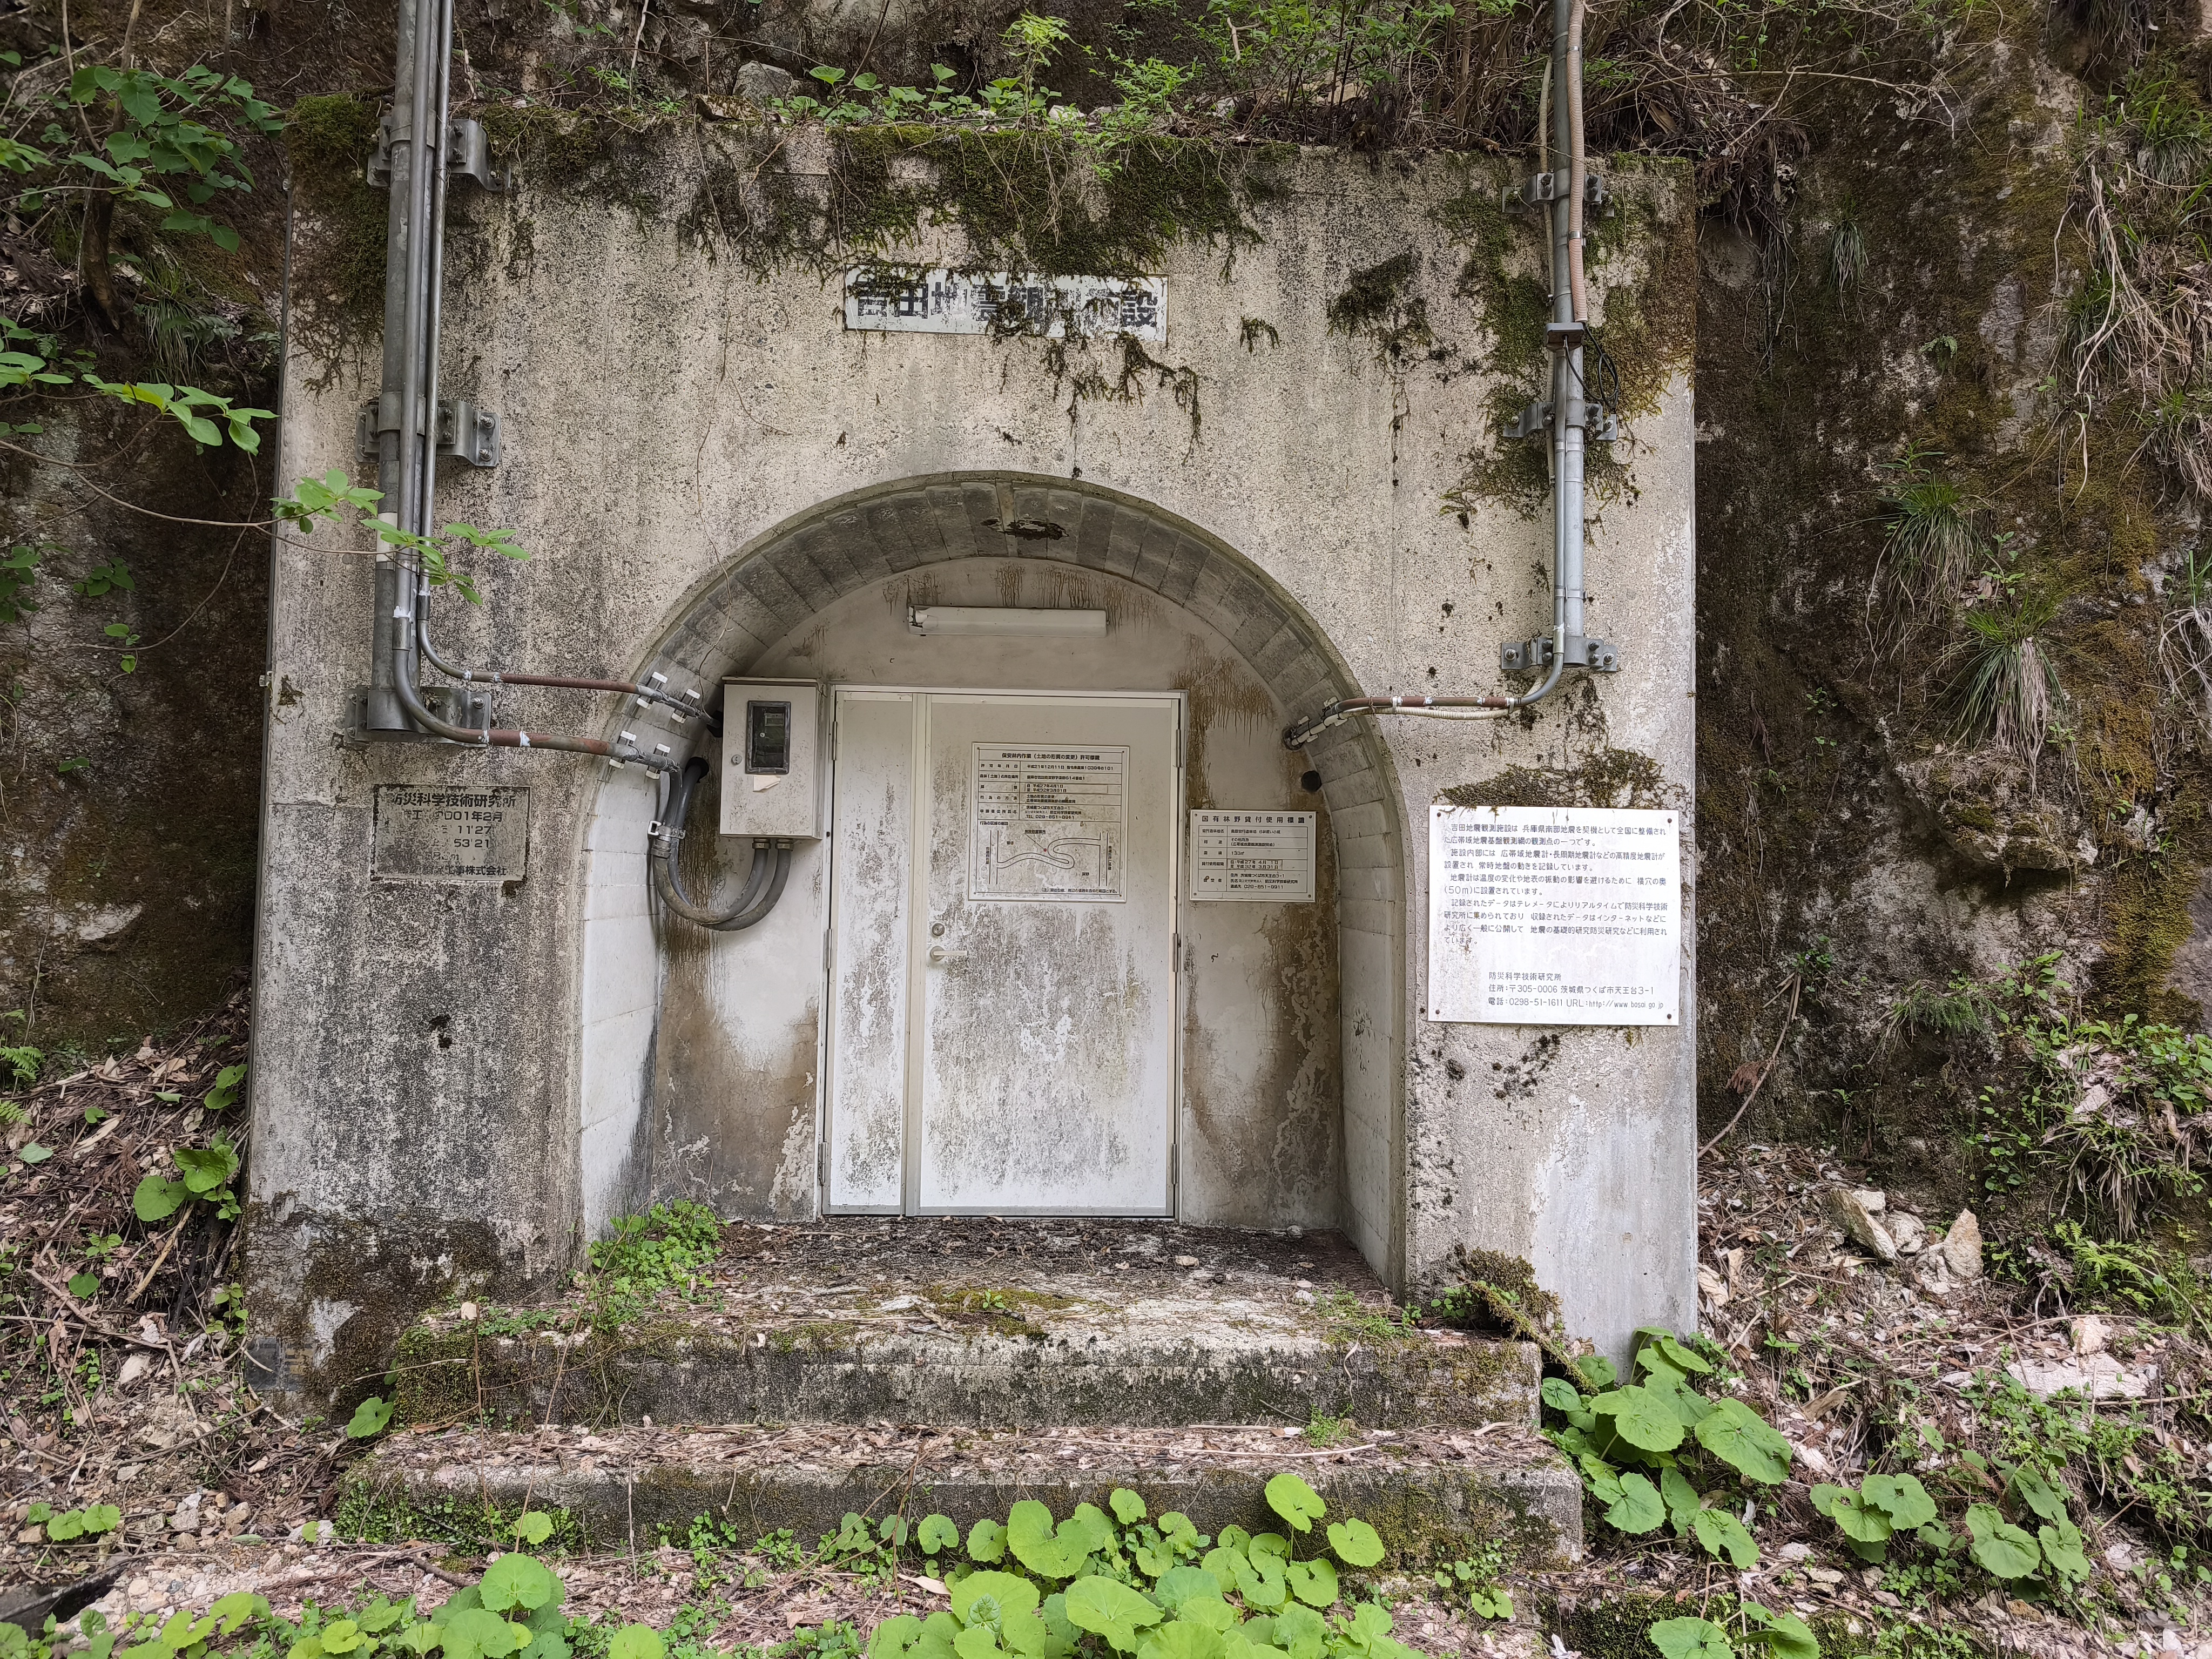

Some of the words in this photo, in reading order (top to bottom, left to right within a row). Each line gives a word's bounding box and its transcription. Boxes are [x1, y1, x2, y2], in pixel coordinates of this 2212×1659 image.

[1202, 815, 1305, 824] 国有林野貸付使用標識
[1451, 824, 1518, 832] 吉田地震観測施設は
[1522, 825, 1666, 835] 兵庫県南部地震を契機として全国に整備され
[1444, 837, 1595, 846] た広帯域地震基盤観測網の観測点の一つです。
[1451, 848, 1495, 857] 施設内部には
[1500, 849, 1665, 860] 広帯域地震計・長周期地震計などの高精度地震計が
[1444, 860, 1473, 869] 設置され
[1479, 861, 1593, 872] 常時地盤の動きを記録しています。
[1450, 873, 1632, 885] 地震計は温度の変化や地表の振動の影響を避けるために
[1637, 877, 1666, 886] 横穴の奥
[1451, 899, 1668, 911] 記録されたデータはテレメータによりリアルタイムで防災科学技術
[1444, 911, 1524, 920] 研究所に集められており
[1530, 913, 1666, 922] 収録されたデータはインターネットなどに
[1444, 924, 1524, 933] より広く一般に公開して
[1530, 926, 1668, 936] 地震の基礎的研究防災研究などに利用され
[1444, 936, 1478, 945] ています。
[1489, 972, 1562, 981] 防災科学技術研究所
[1560, 986, 1654, 995] 茨城県つくば市天王台3-1
